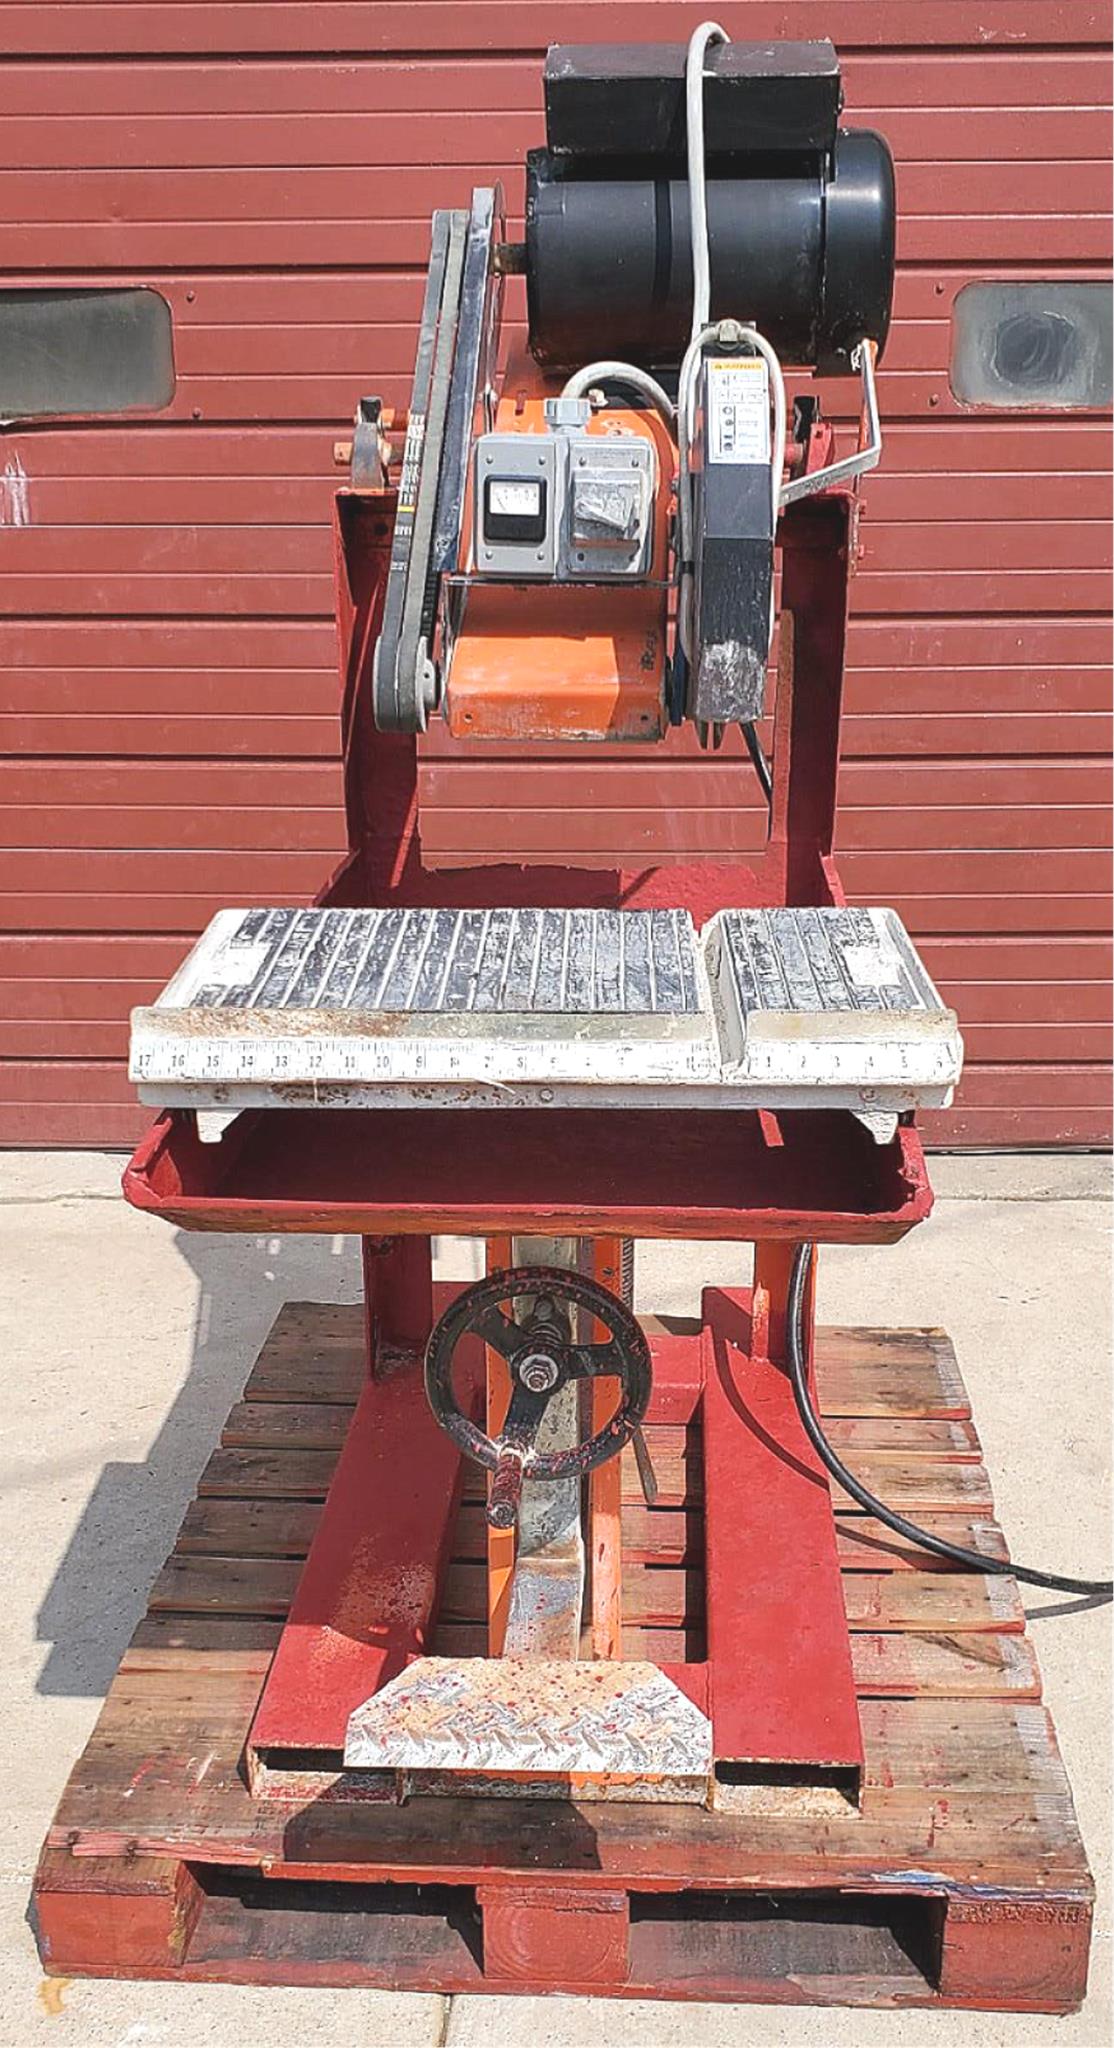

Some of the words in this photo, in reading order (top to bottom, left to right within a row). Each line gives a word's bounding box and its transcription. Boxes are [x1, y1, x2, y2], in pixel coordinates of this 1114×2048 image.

[138, 1054, 152, 1067] 17
[172, 1054, 185, 1067] 16
[207, 1055, 219, 1067] 15
[241, 1055, 254, 1067] 14
[275, 1055, 288, 1068] 13
[309, 1055, 323, 1068] 12
[345, 1055, 356, 1068] 11
[376, 1055, 390, 1068] 10
